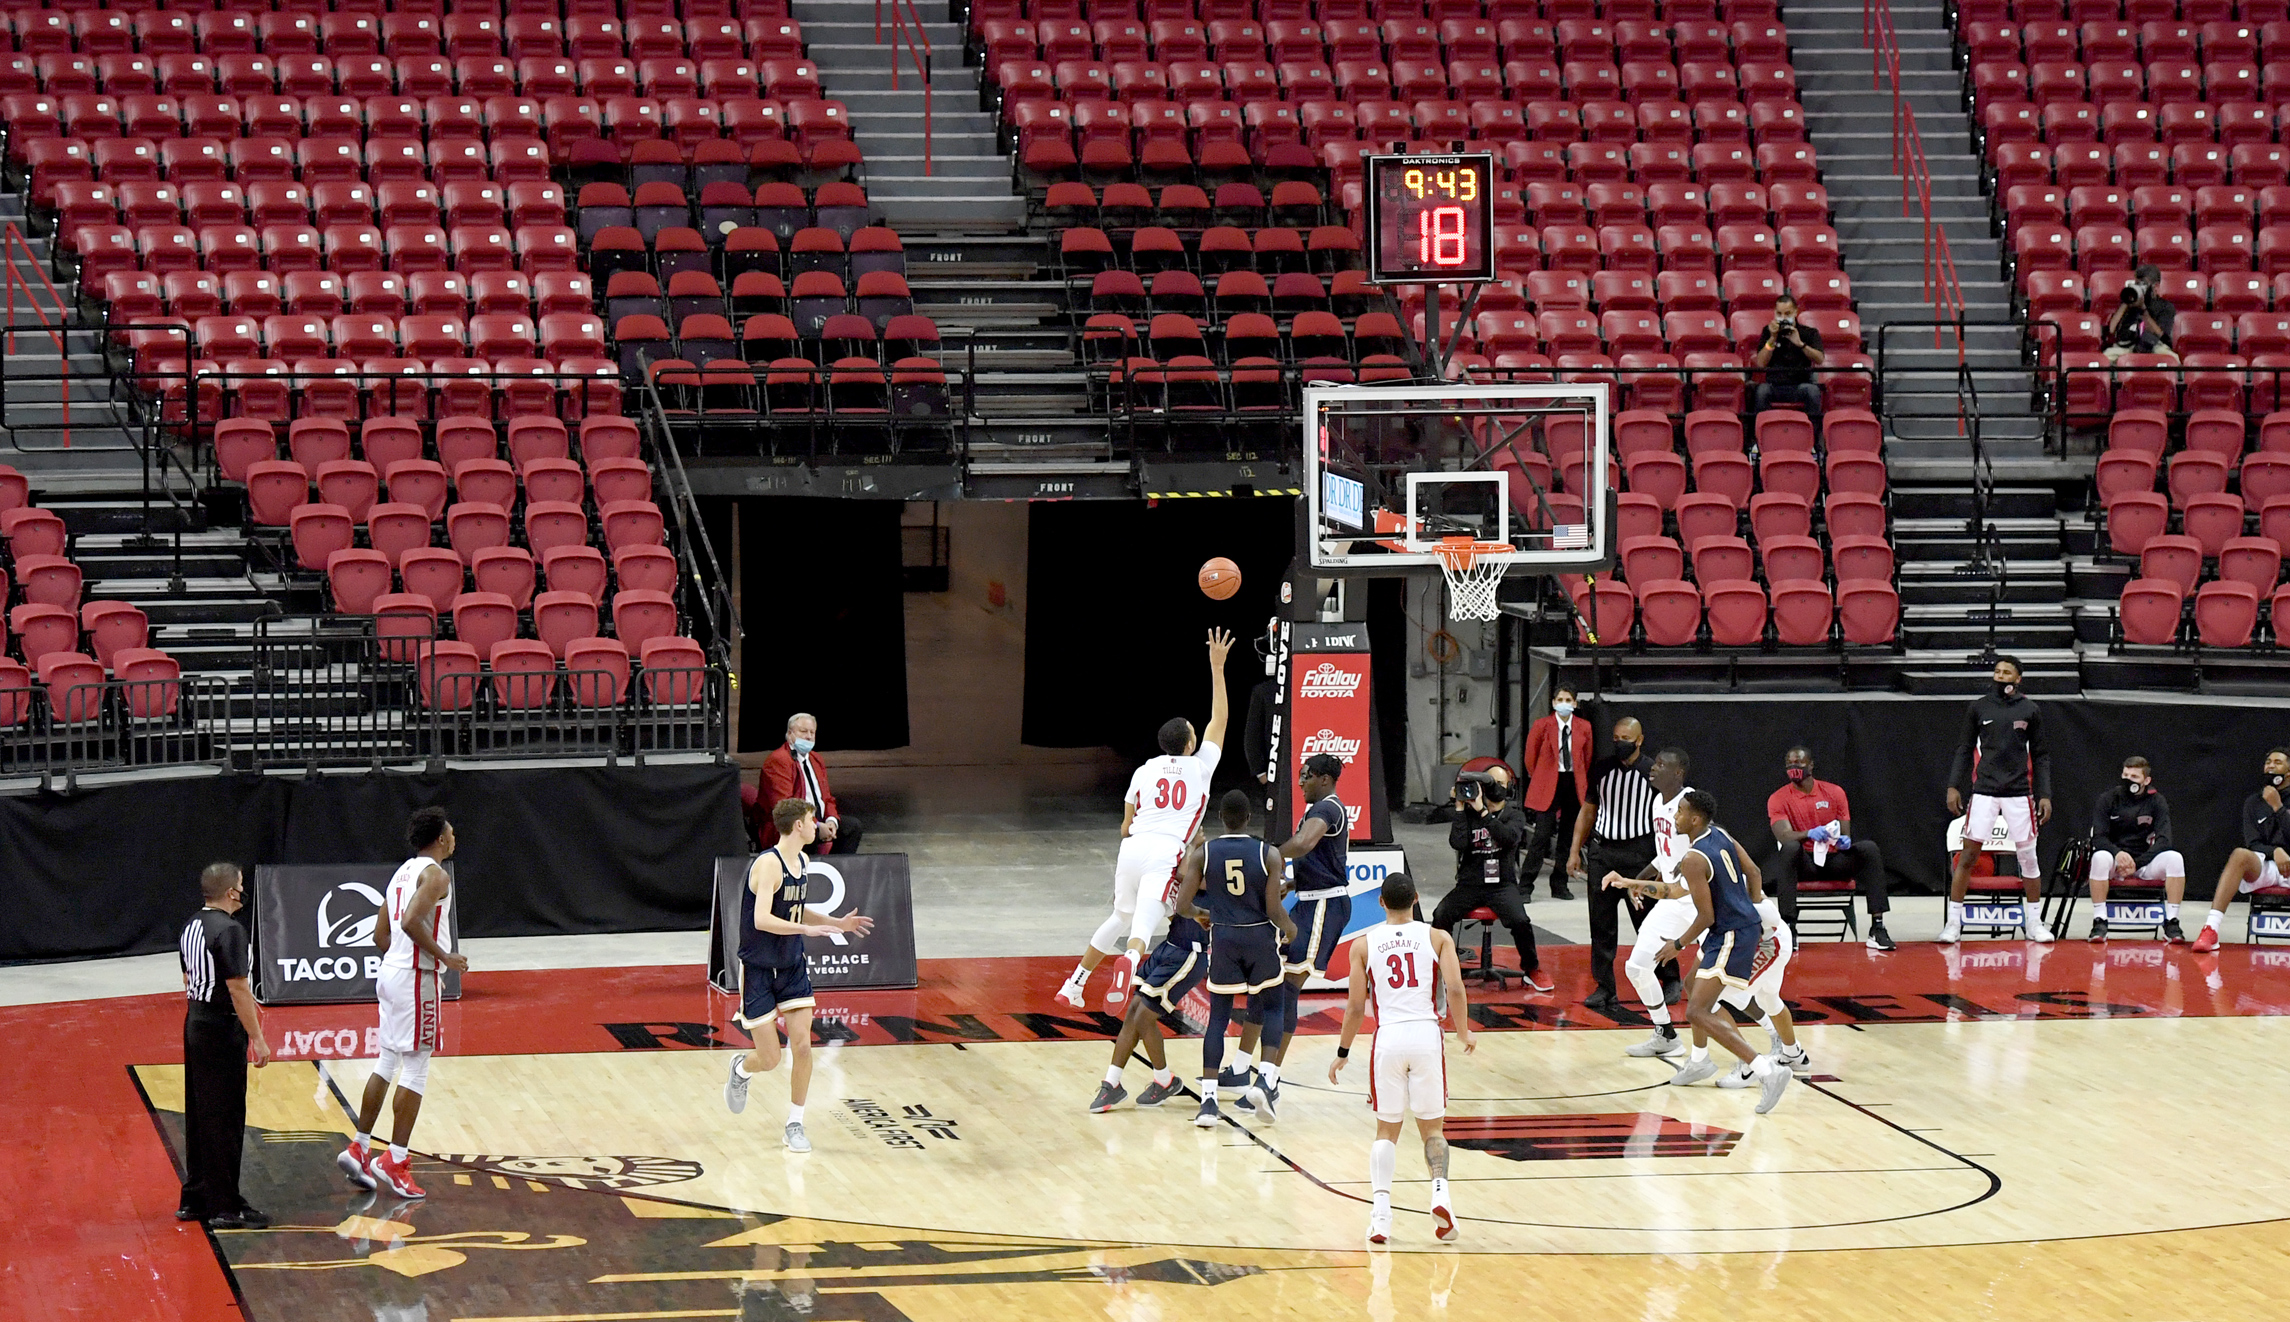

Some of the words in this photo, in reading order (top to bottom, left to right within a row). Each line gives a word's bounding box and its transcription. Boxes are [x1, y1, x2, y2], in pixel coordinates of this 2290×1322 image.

[1402, 157, 1461, 165] DAKTRONICS
[1404, 168, 1478, 202] 9:43
[1419, 205, 1466, 267] 18
[929, 252, 963, 262] FRONT
[1018, 434, 1052, 443] FRONT
[1040, 482, 1075, 493] FRONT
[1338, 478, 1352, 511] DR
[1318, 557, 1348, 565] SPALDING
[1274, 620, 1291, 705] LOVE
[1302, 669, 1362, 690] Findlay
[1300, 689, 1355, 698] TOYOTA
[1267, 713, 1282, 783] ONE
[1301, 735, 1361, 756] Findlay
[1162, 765, 1183, 776] TILLIS
[1154, 777, 1188, 811] 30
[1719, 848, 1739, 884] 0
[1224, 858, 1247, 897] 5
[1961, 906, 2024, 925] UMC
[2251, 915, 2290, 935] UM
[1377, 939, 1412, 955] COLEMAN
[277, 956, 358, 982] TACO
[822, 953, 870, 965] PLACE
[812, 966, 849, 975] VEGAS
[1386, 952, 1420, 990] 31
[418, 999, 436, 1048] UNLV
